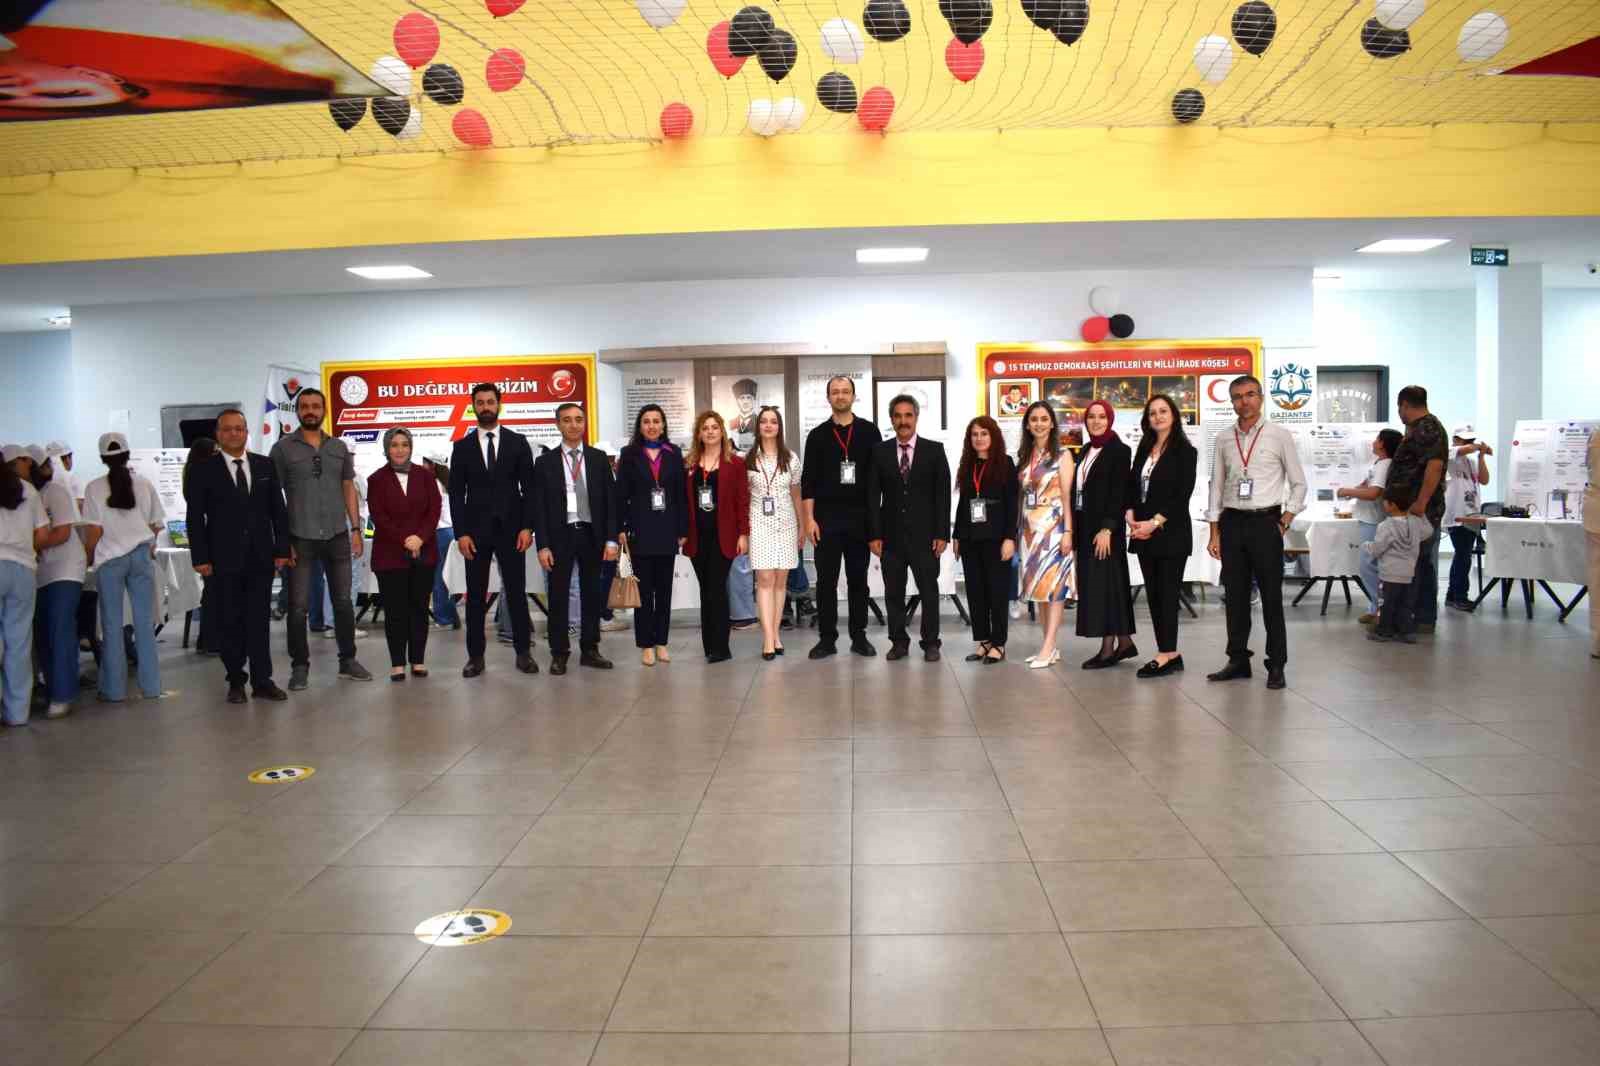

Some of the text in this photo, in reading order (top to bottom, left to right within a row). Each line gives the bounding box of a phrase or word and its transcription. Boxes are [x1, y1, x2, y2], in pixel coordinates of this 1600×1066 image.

[1008, 357, 1229, 372] 15 TEMMUZ DEMOKRASİ ŞEHİTLERİ VE MİLLİ İRADE KÖŞESİ
[377, 377, 538, 398] BU DEĞERLE BİZİM
